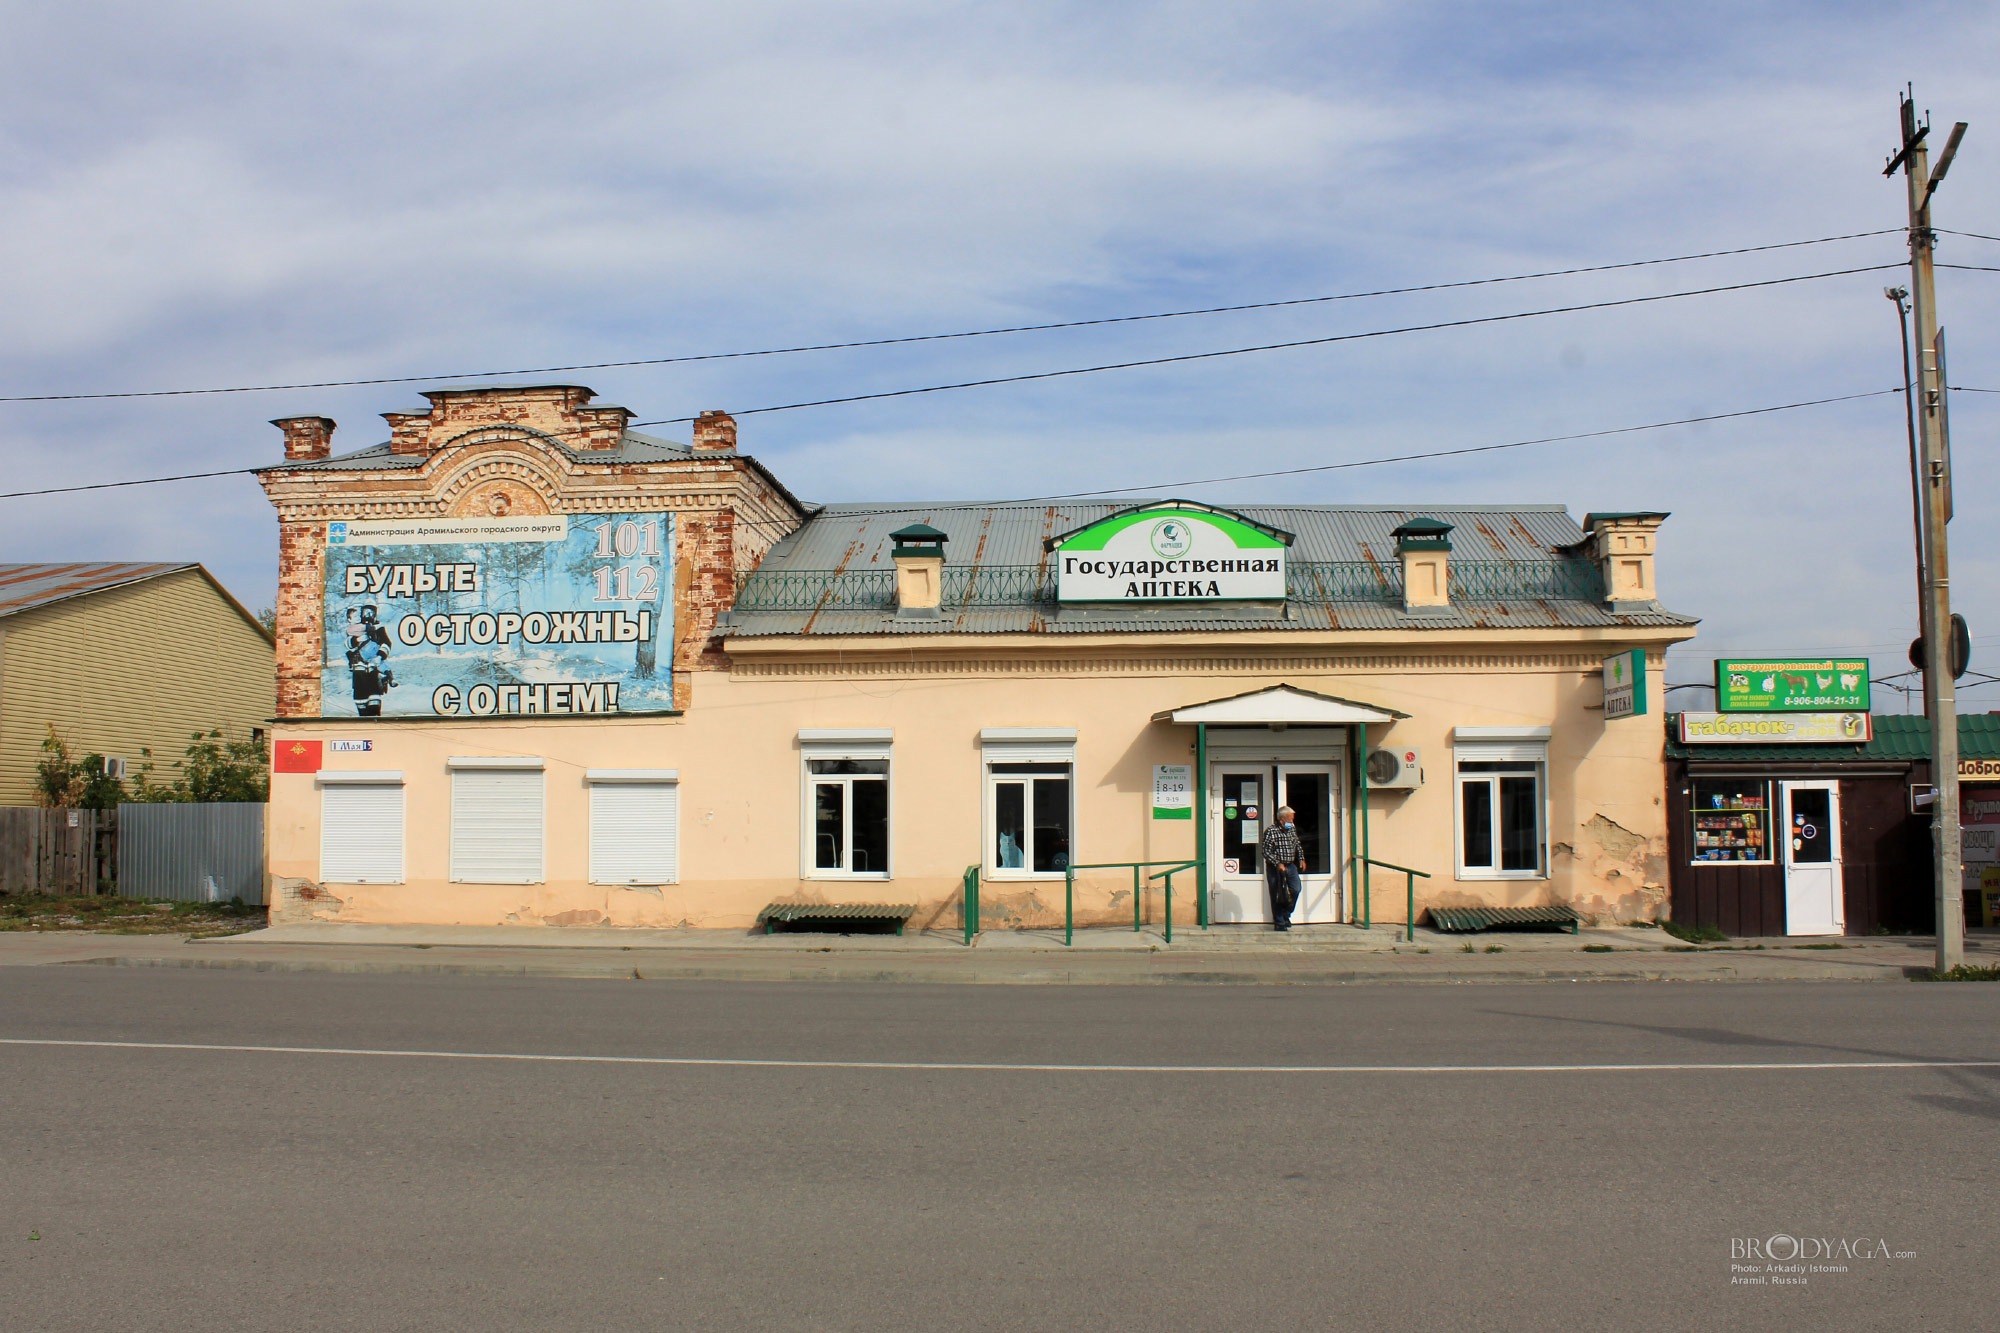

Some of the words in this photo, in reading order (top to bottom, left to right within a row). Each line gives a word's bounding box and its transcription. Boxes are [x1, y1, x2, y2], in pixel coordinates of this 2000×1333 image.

[348, 528, 415, 538] Администрация
[417, 525, 478, 536] Арамильского
[480, 525, 529, 535] городского
[531, 524, 561, 534] округа
[594, 521, 661, 558] 101
[1065, 557, 1280, 578] Государственная
[345, 562, 476, 598] БУДЬТЕ
[593, 565, 659, 601] 112
[1124, 580, 1221, 598] АПТЕКА
[398, 610, 651, 645] ОСТОРОЖНЫ
[1836, 662, 1865, 672] корм
[432, 684, 460, 715] С
[467, 682, 620, 714] ОГНЕМ!
[1607, 696, 1631, 714] АПТЕКА
[1784, 697, 1860, 705] 8-906-804-21-31
[1808, 716, 1837, 725] ЧАЙ
[1798, 727, 1837, 736] КОФЕ
[340, 741, 361, 750] Мая
[363, 741, 372, 750] 15
[1162, 783, 1184, 792] 8-19
